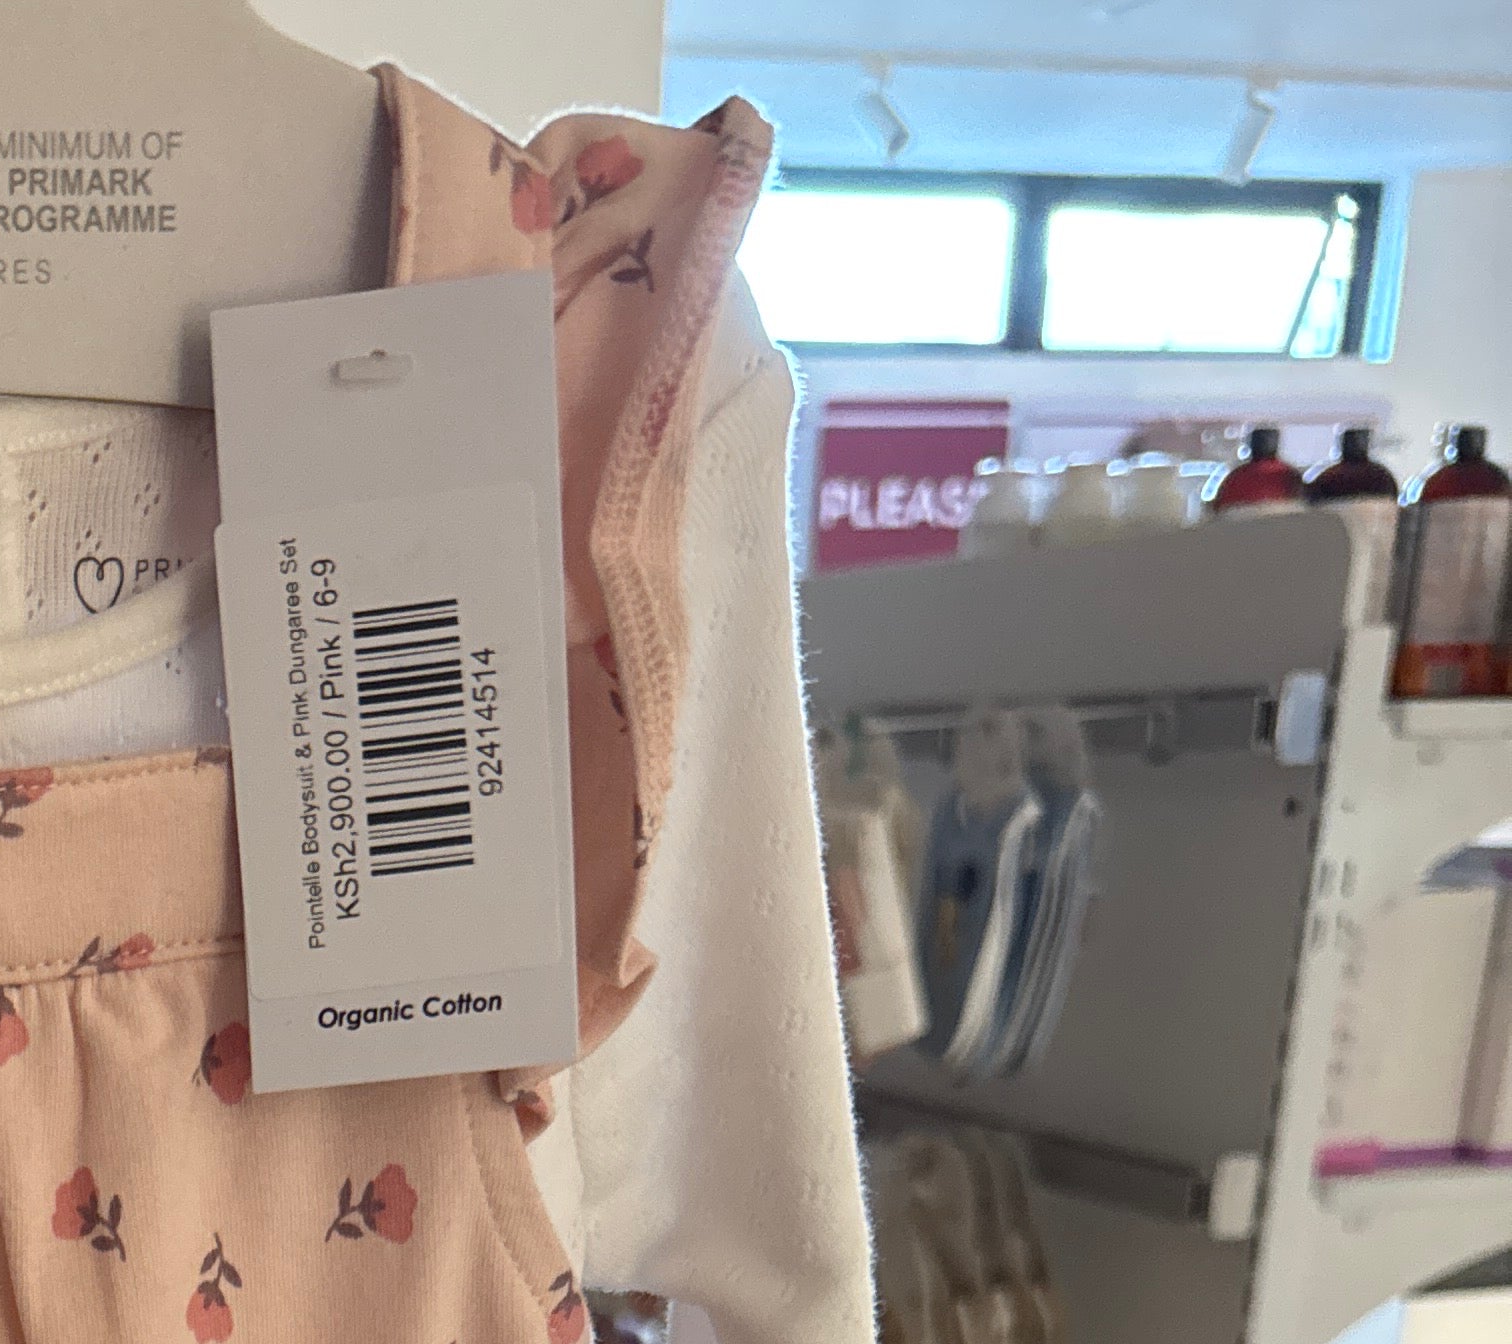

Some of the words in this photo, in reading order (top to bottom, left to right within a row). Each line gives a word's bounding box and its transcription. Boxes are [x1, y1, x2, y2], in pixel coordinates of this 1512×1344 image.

[140, 130, 184, 160] OF
[8, 167, 153, 197] PRIMARK
[279, 536, 299, 575] Set
[309, 557, 339, 608] 6-9
[285, 581, 308, 685] Dungaree
[316, 634, 345, 701] Pink
[291, 690, 311, 738] Pink
[469, 647, 504, 797] 92414514
[294, 742, 313, 759] &
[295, 764, 321, 856] Bodysuit
[323, 729, 361, 921] KSh2,900.00
[302, 860, 326, 950] Pointelle
[317, 999, 414, 1031] Organic
[422, 991, 503, 1018] Cotton
